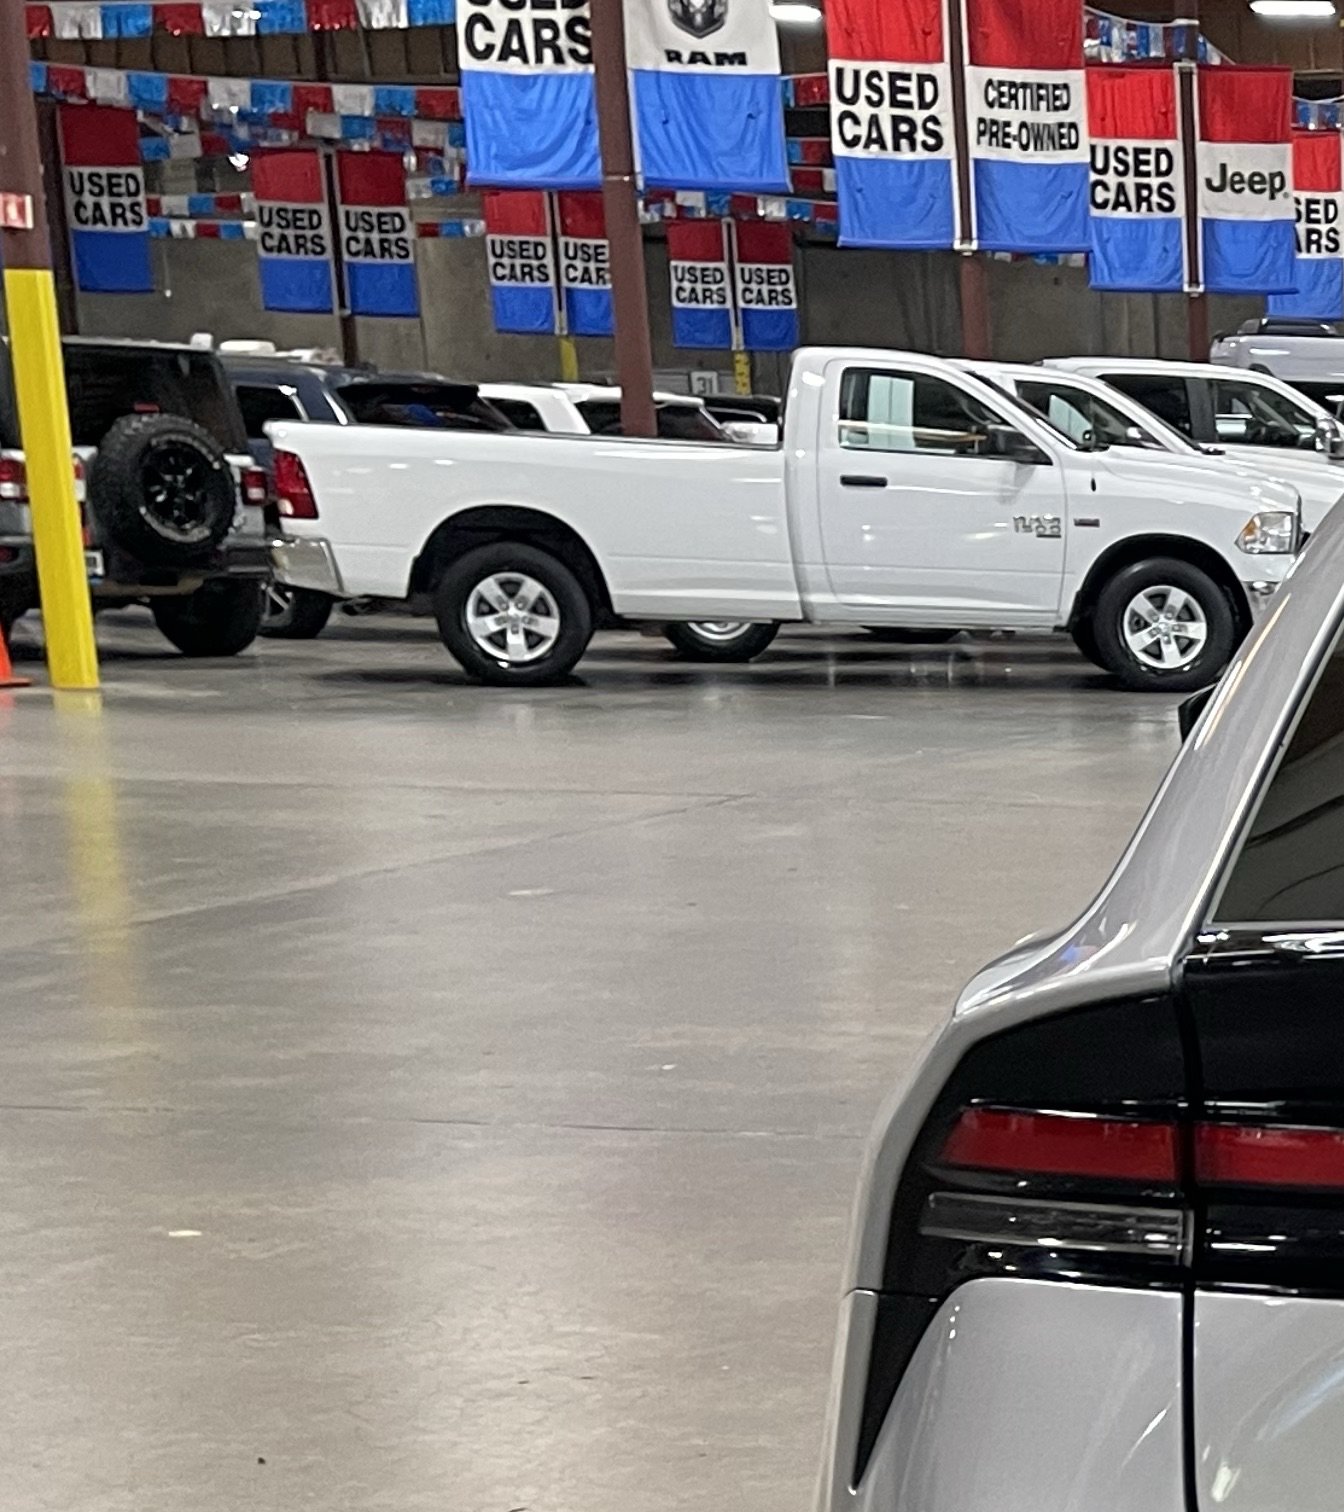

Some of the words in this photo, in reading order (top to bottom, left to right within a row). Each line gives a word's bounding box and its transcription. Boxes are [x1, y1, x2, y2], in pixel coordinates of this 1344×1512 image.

[464, 12, 592, 64] CARS
[665, 49, 747, 66] RAM
[834, 66, 939, 110] USED
[984, 78, 1071, 112] CERTIFIED
[837, 111, 944, 152] CARS
[977, 117, 1080, 151] PRE-OWNED
[1089, 144, 1174, 177] USED
[69, 172, 140, 198] USED
[1205, 163, 1286, 199] Jeep
[1089, 179, 1176, 212] CARS
[74, 202, 144, 226] CARS
[259, 205, 322, 230] USED
[345, 210, 406, 233] USED
[261, 232, 326, 256] CARS
[345, 235, 410, 259] CARS
[490, 239, 547, 260] USED
[564, 241, 607, 263] USE
[492, 263, 550, 283] CARS
[565, 263, 607, 285] CAR
[674, 264, 724, 284] USED
[741, 265, 790, 286] USED
[675, 285, 726, 305] CARS
[741, 287, 793, 306] CARS
